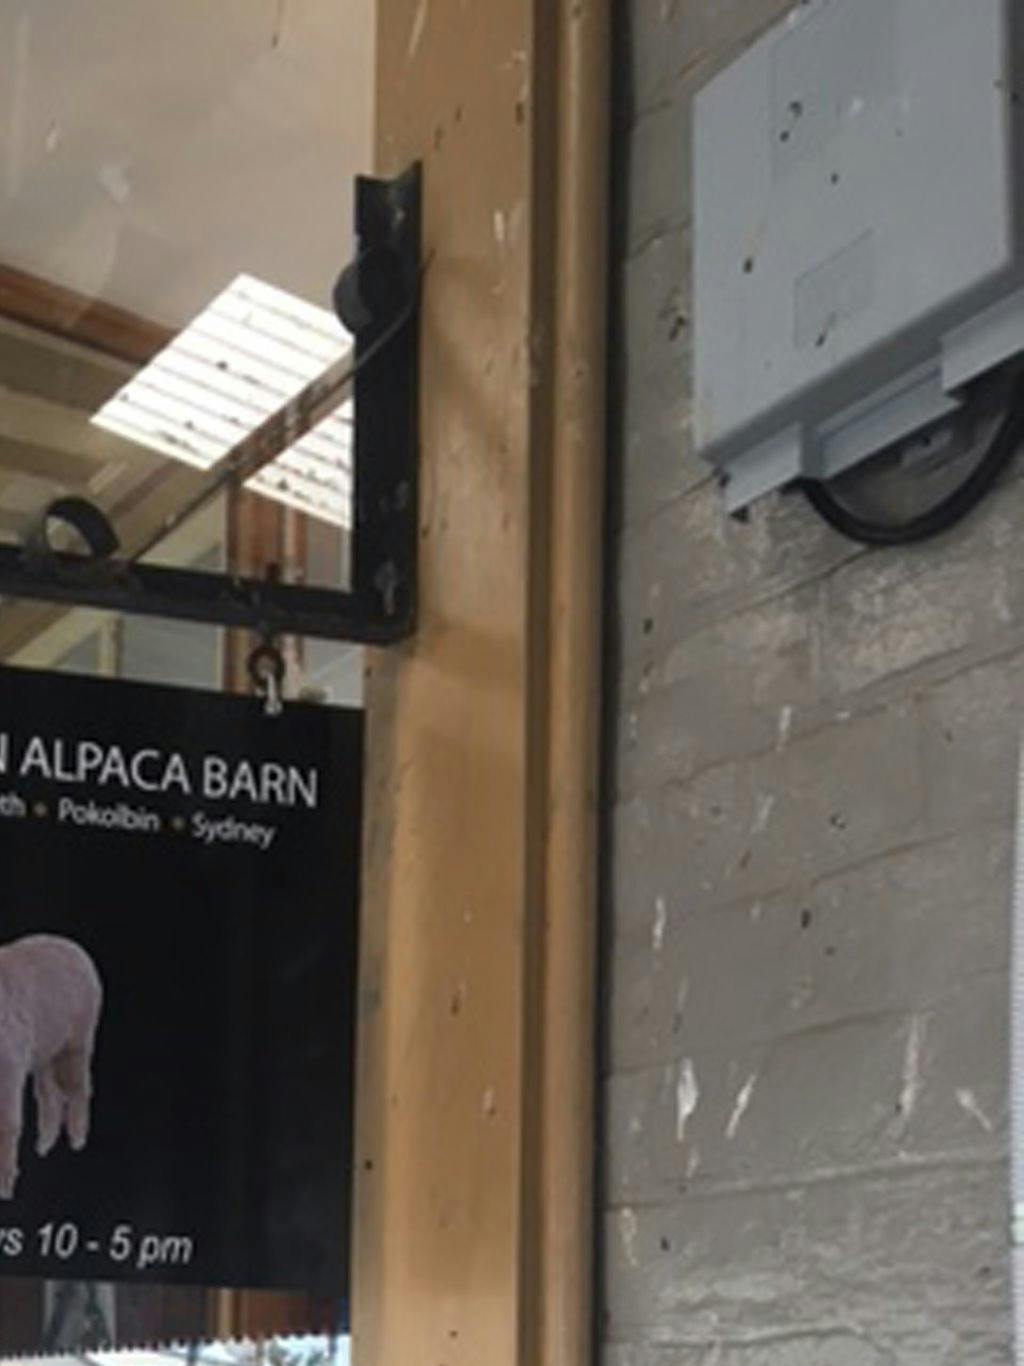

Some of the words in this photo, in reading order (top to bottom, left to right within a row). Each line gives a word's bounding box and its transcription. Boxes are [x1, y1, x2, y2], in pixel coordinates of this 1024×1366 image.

[20, 736, 191, 795] ALPACA
[203, 755, 318, 808] BARN
[57, 797, 160, 832] Pokolbin
[190, 811, 274, 849] Sydney
[37, 1222, 78, 1259] 10
[110, 1224, 133, 1262] 5
[137, 1234, 194, 1269] pm
